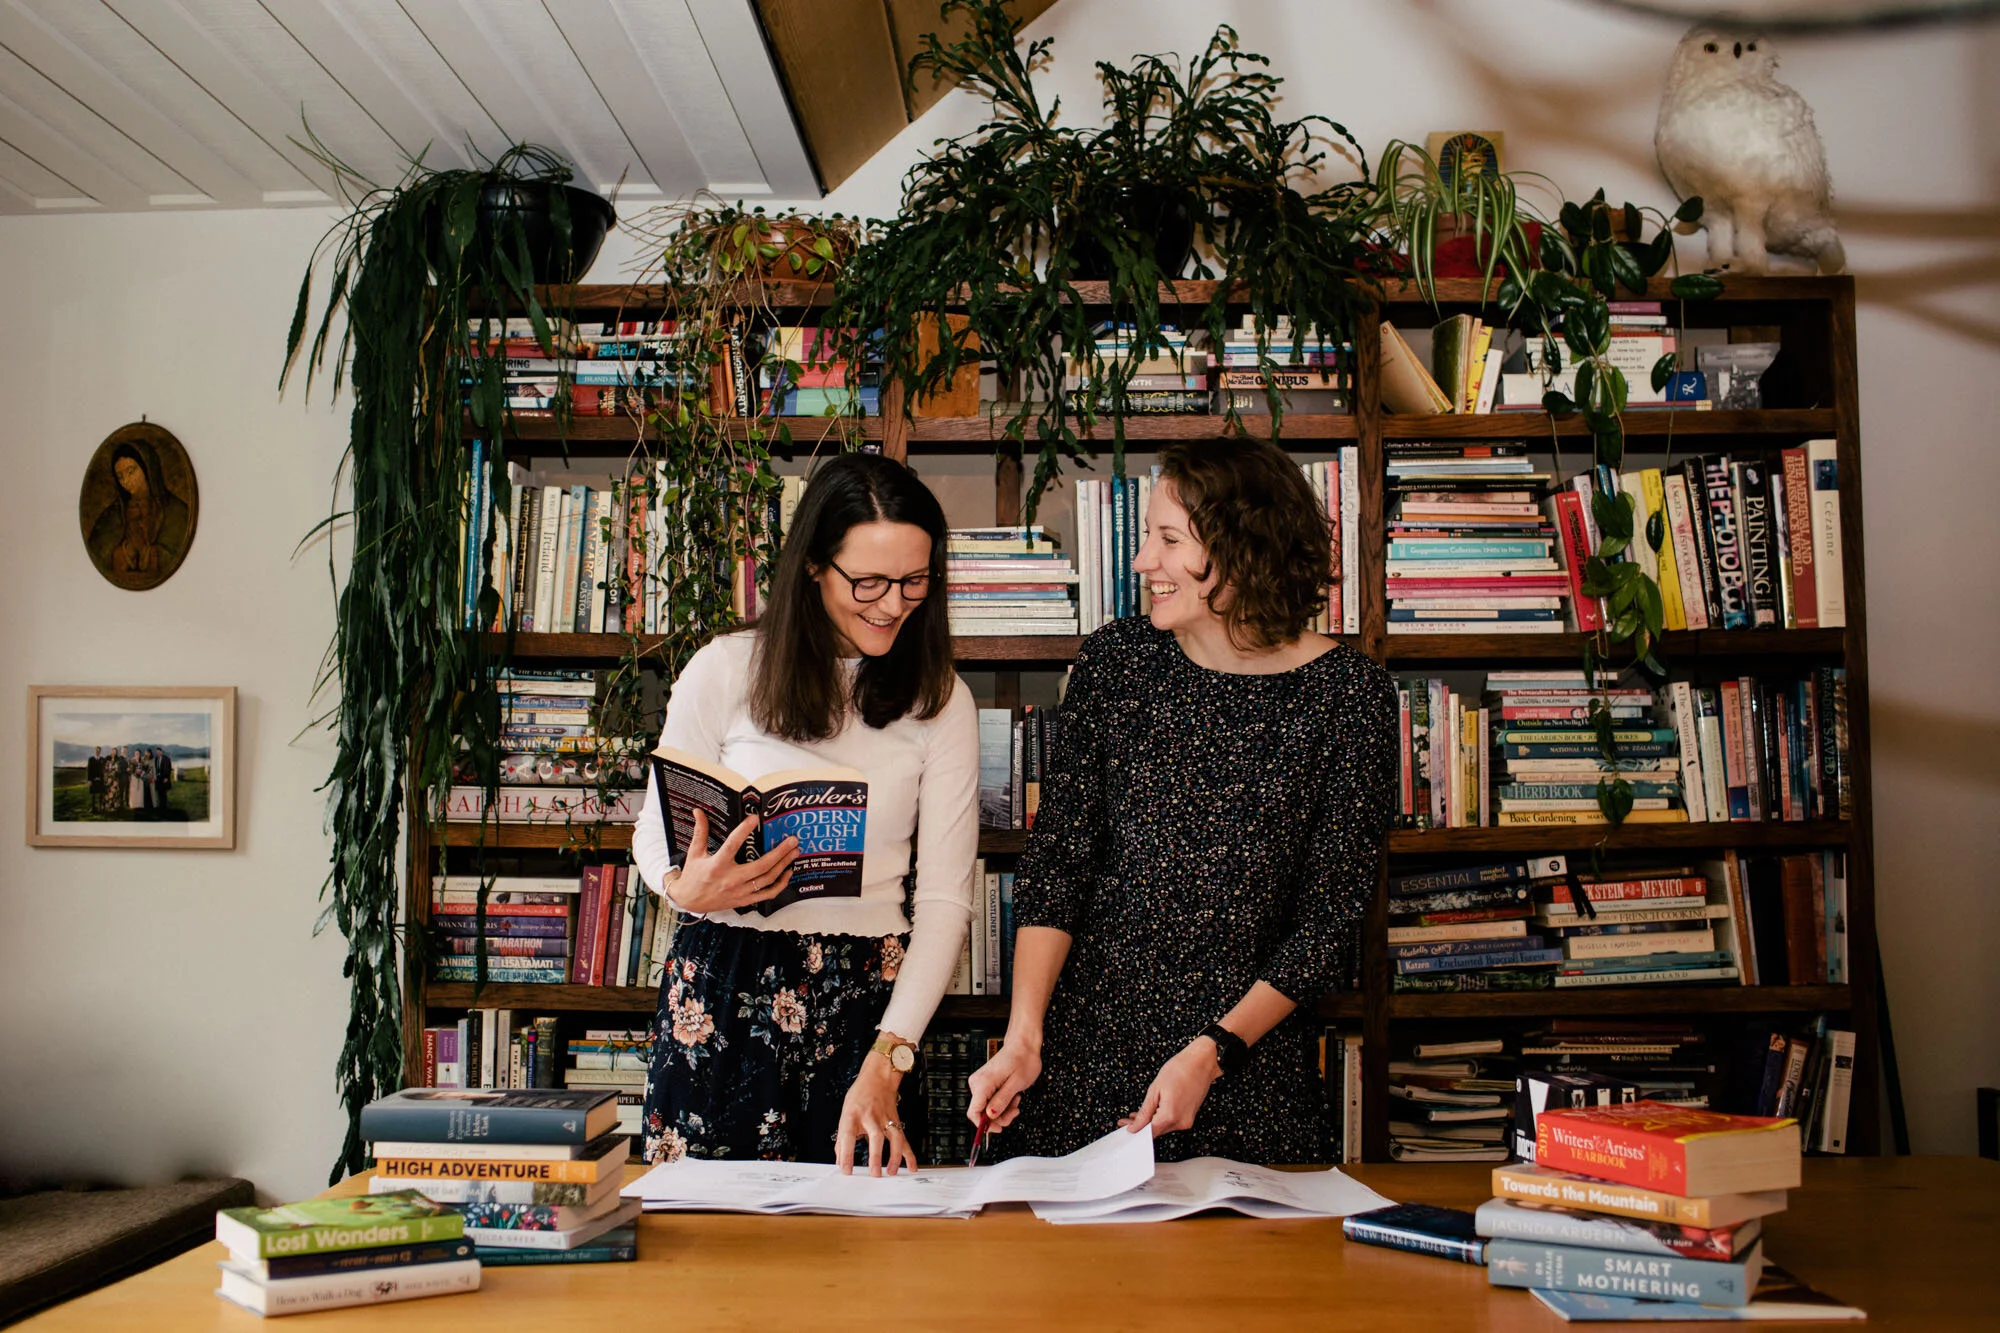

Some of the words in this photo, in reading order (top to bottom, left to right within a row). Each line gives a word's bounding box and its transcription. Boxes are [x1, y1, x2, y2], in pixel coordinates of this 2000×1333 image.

[1794, 455, 1805, 478] THE
[1785, 456, 1799, 531] RENAISSANCE
[1115, 493, 1124, 532] CABINS
[1795, 480, 1808, 536] MEDIEVAL
[1824, 501, 1836, 557] Cézanne
[1745, 495, 1772, 595] PAINTING
[1791, 534, 1803, 577] WORLD
[1802, 538, 1812, 565] AND
[577, 581, 588, 616] CASTOR
[1677, 690, 1688, 709] The
[1520, 735, 1533, 743] THE
[1534, 735, 1560, 743] GARDEN
[1561, 735, 1582, 743] BOOK
[1682, 713, 1695, 758] Naturalist
[1823, 727, 1837, 775] SAVED
[801, 786, 827, 795] NEW
[1514, 785, 1548, 799] HERB
[1549, 785, 1583, 799] BOOK
[763, 786, 866, 818] Fowler's
[766, 810, 862, 834] MODERN
[1509, 813, 1531, 824] Basic
[1533, 813, 1577, 825] Gardening
[797, 838, 847, 855] SAGE
[820, 860, 857, 869] Burchfield
[798, 884, 825, 893] Oxford
[1400, 872, 1472, 893] ESSENTIAL
[1641, 879, 1683, 898] MEXICO
[989, 888, 997, 938] COASTLINERS
[1619, 911, 1661, 922] FRENCH
[1661, 908, 1706, 921] COOKING
[493, 937, 543, 949] MARATHON
[500, 958, 520, 967] LISA
[519, 959, 554, 968] TAMATI
[1405, 961, 1430, 971] Katzen
[1438, 958, 1483, 969] Enchanted
[1564, 976, 1612, 985] COUNTRY
[1616, 975, 1638, 983] NEW
[1642, 971, 1689, 982] ZEALAND
[426, 1034, 434, 1064] NANCY
[1536, 1122, 1549, 1158] 2019
[1604, 1140, 1647, 1162] Artists'
[386, 1161, 433, 1176] HIGH
[438, 1163, 550, 1179] ADVENTURE
[1569, 1148, 1627, 1170] YEARBOOK
[1500, 1176, 1560, 1202] Towards
[1562, 1185, 1587, 1202] the
[1588, 1188, 1659, 1213] Mountain
[266, 1232, 309, 1254] Lost
[314, 1224, 409, 1249] Wonders
[1354, 1227, 1378, 1240] NEW
[1491, 1219, 1557, 1236] JACINDA
[1560, 1225, 1627, 1244] ARDERN
[1603, 1257, 1674, 1278] SMART
[276, 1295, 298, 1306] How
[311, 1289, 335, 1303] Walk
[343, 1287, 362, 1300] Dog
[1576, 1273, 1702, 1299] MOTHERING
